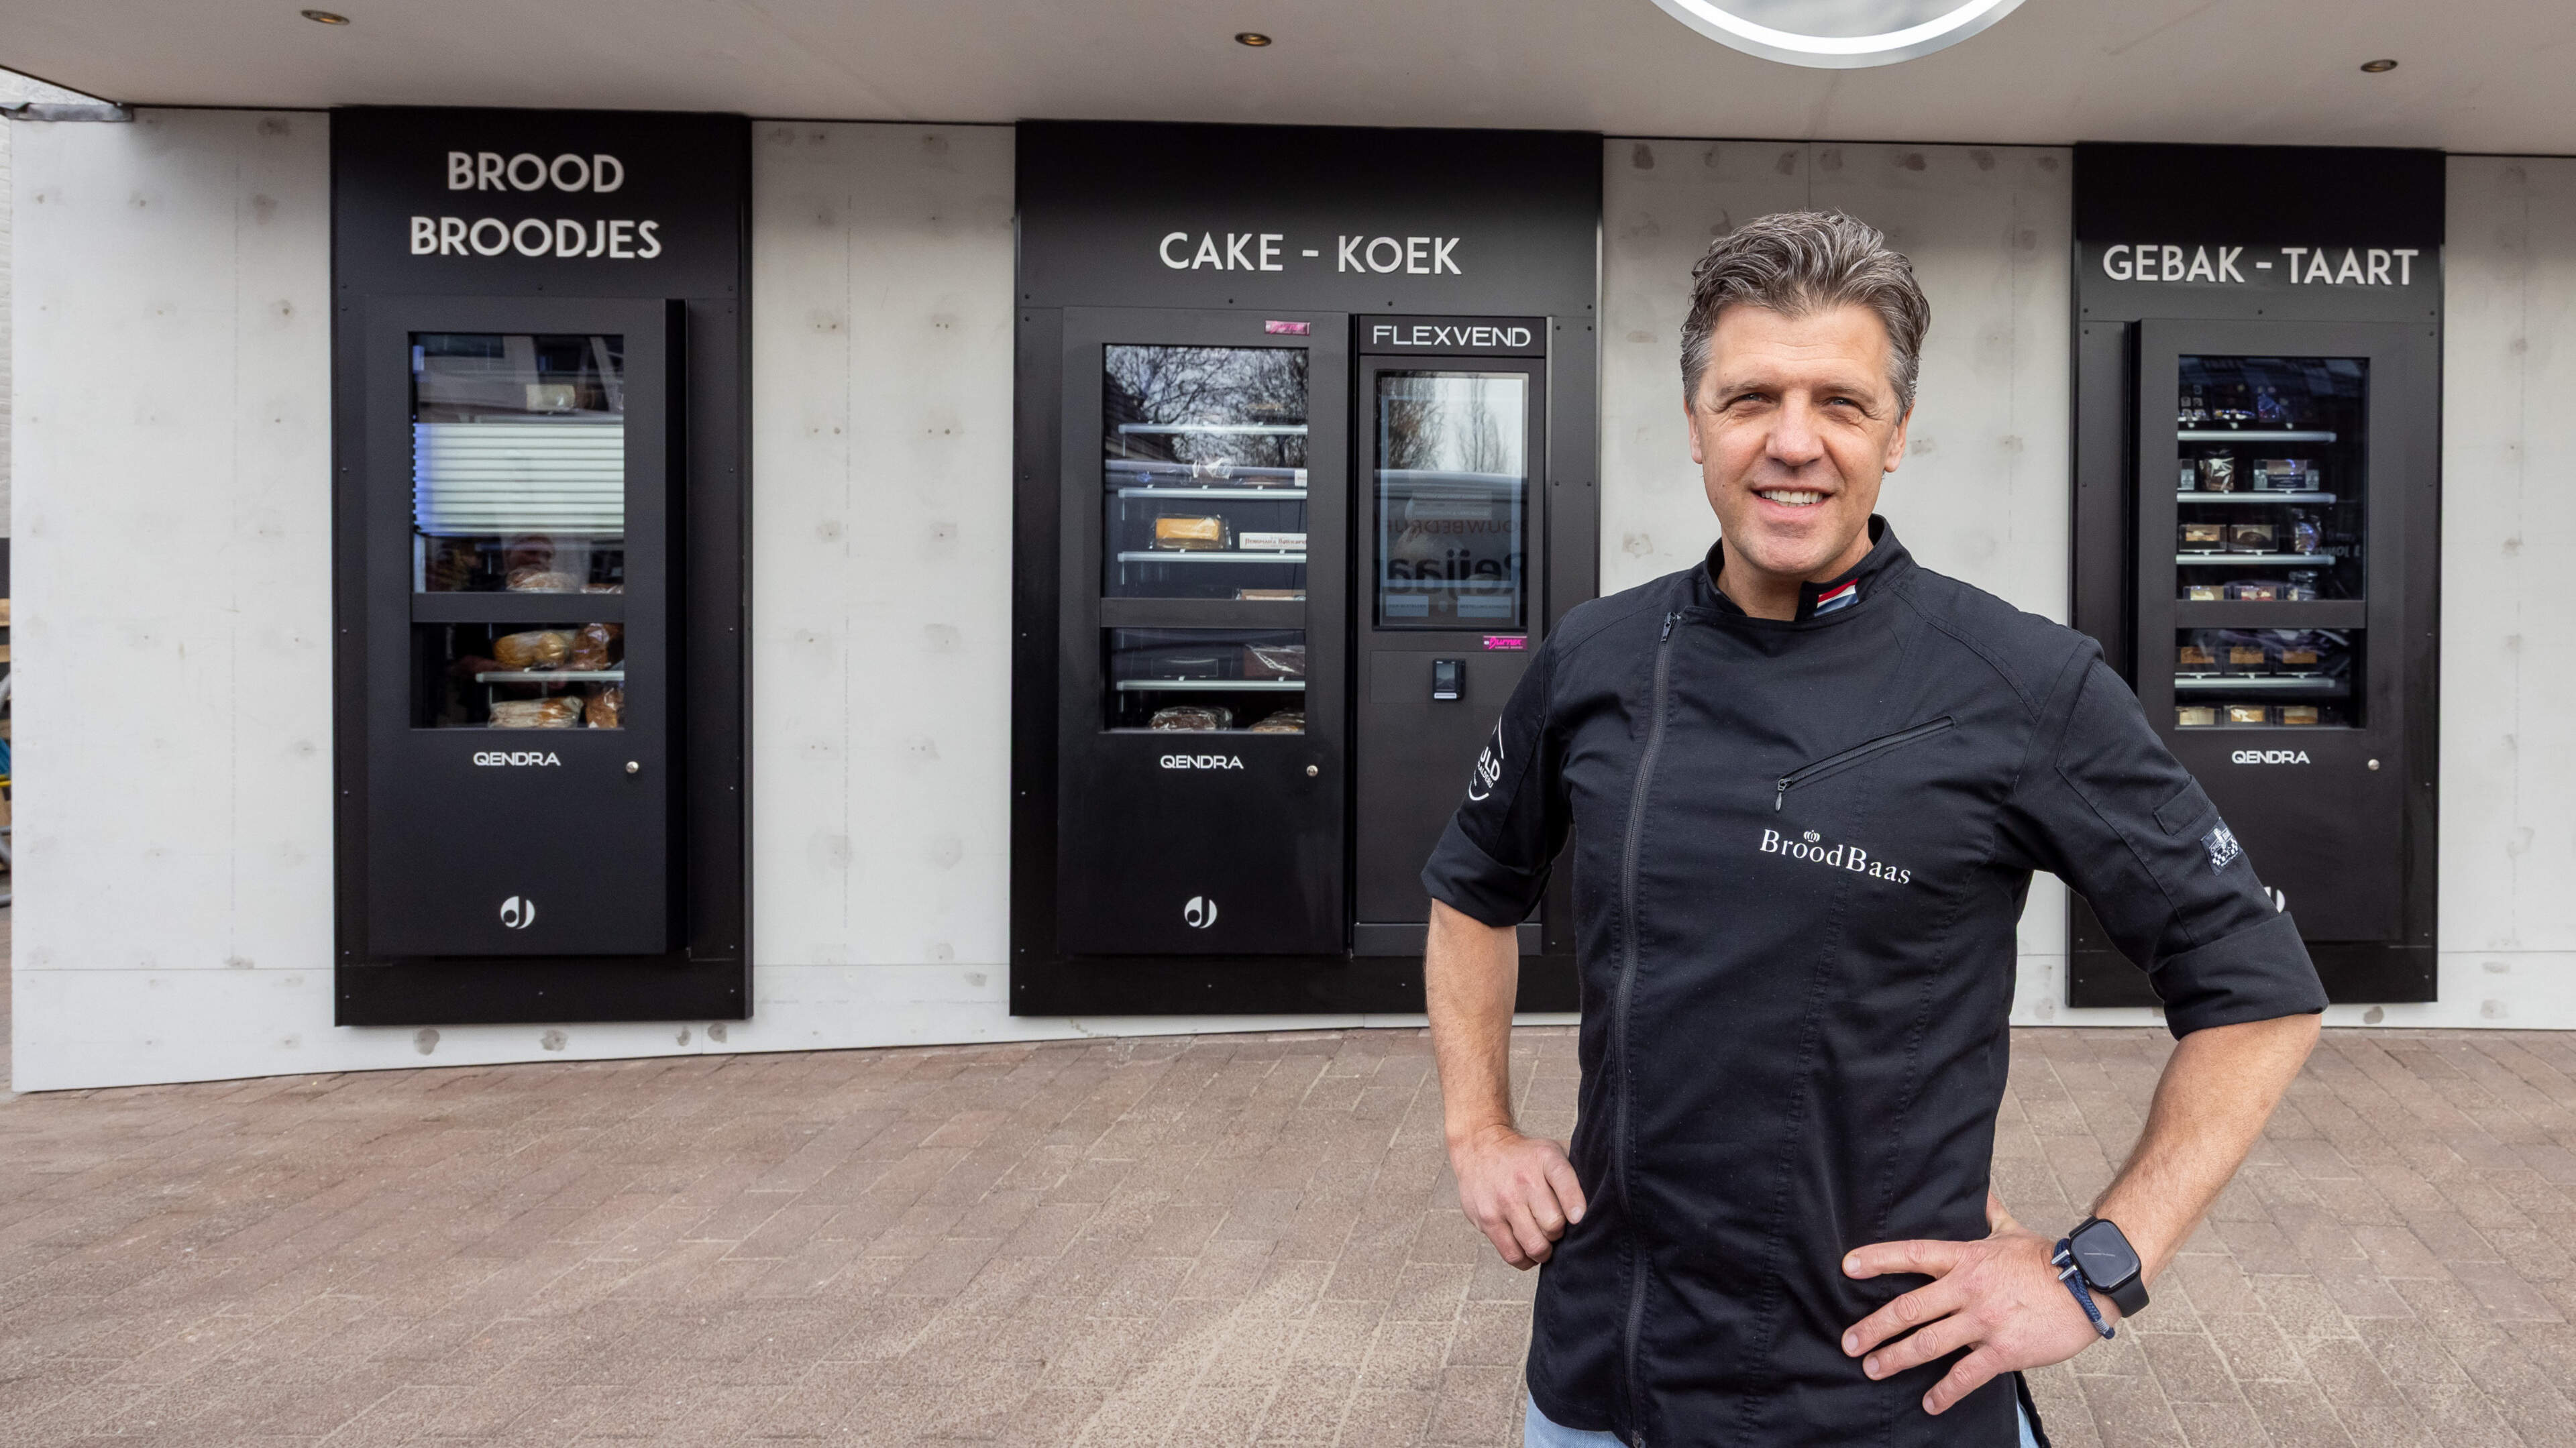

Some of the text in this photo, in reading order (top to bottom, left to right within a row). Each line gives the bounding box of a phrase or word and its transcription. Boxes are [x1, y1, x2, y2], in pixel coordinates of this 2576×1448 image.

[448, 152, 623, 192] BROOD
[411, 217, 662, 260] BROODJES
[1159, 231, 1462, 275] CAKE - KOEK
[2103, 245, 2419, 286] GEBAK - TAART
[1373, 325, 1532, 347] FLEXVEND
[473, 751, 561, 767] QENDRA
[1160, 754, 1244, 770] QENDRA
[2231, 750, 2311, 765] QENDRA
[1760, 828, 1911, 885] BroodBaas
